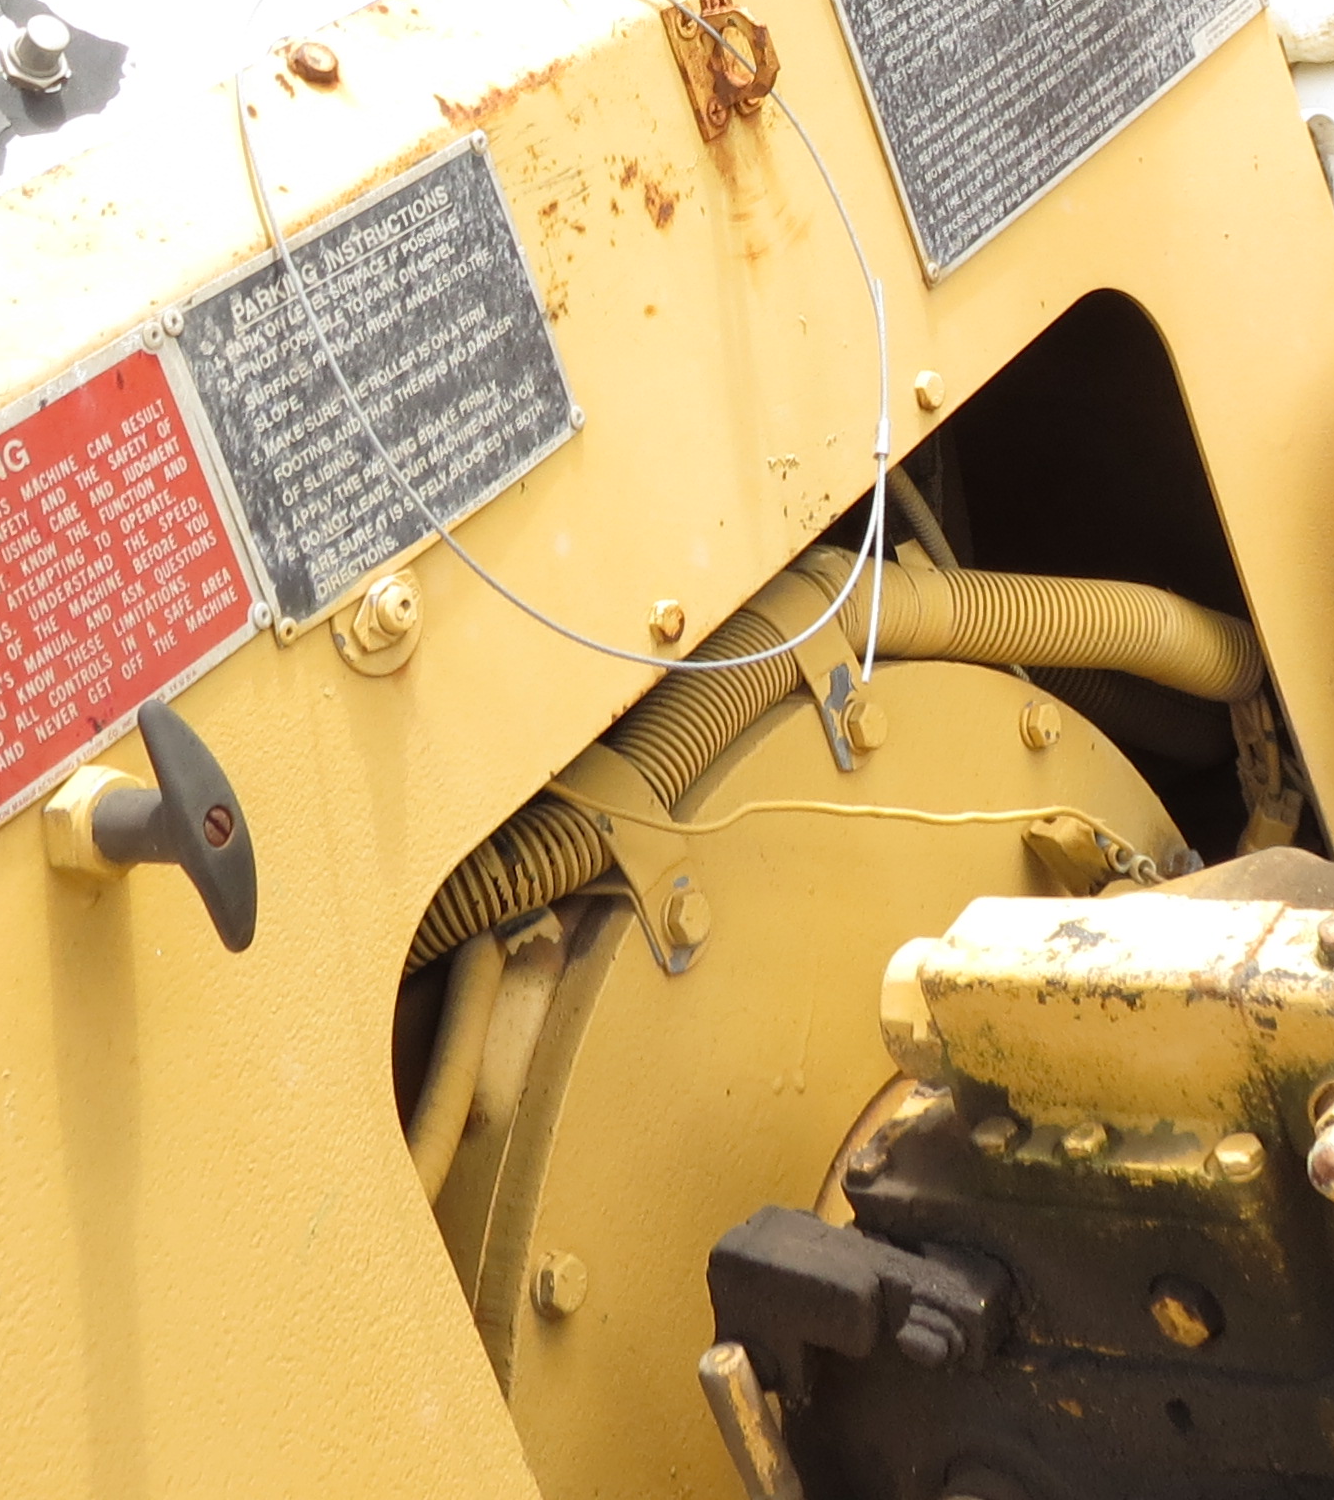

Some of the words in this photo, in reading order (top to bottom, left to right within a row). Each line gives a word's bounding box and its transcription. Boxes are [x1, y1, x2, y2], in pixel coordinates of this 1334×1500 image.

[323, 182, 449, 273] INSTRUCTIONS
[225, 329, 263, 363] PARK
[286, 288, 330, 327] LEEL
[329, 254, 388, 301] SURFACE
[387, 246, 401, 265] IF
[250, 346, 280, 375] NOT
[280, 306, 345, 357] POSSBLE
[344, 294, 364, 318] TO
[364, 274, 398, 306] PARK
[366, 301, 404, 336] RIGHT
[403, 272, 451, 312] ANGLES
[19, 453, 79, 503] MACHINE
[86, 431, 113, 460] CAN
[120, 398, 165, 438] RESULT
[273, 433, 333, 484] FOOTING
[333, 415, 361, 445] AND
[466, 314, 514, 356] DANGER
[1, 526, 42, 564] USING
[49, 500, 81, 533] CARE
[89, 479, 114, 508] AND
[122, 435, 180, 486] JUDGMENT
[19, 540, 57, 577] KNOW
[65, 518, 91, 546] THE
[98, 476, 155, 525] FUNCTION
[163, 455, 188, 483] AND
[40, 486, 67, 515] AND
[74, 463, 100, 491] THE
[107, 432, 148, 471] SAFETY
[156, 416, 171, 438] OF
[281, 484, 302, 508] OF
[290, 491, 334, 531] APPLY
[334, 473, 361, 502] THE
[416, 407, 459, 446] BRAKE
[6, 547, 85, 612] ATTEMPTING
[93, 530, 112, 552] TO
[119, 488, 177, 534] OPERATE.
[28, 553, 114, 622] UNDERSTAND
[122, 528, 149, 556] THE
[158, 495, 203, 533] SPEED,
